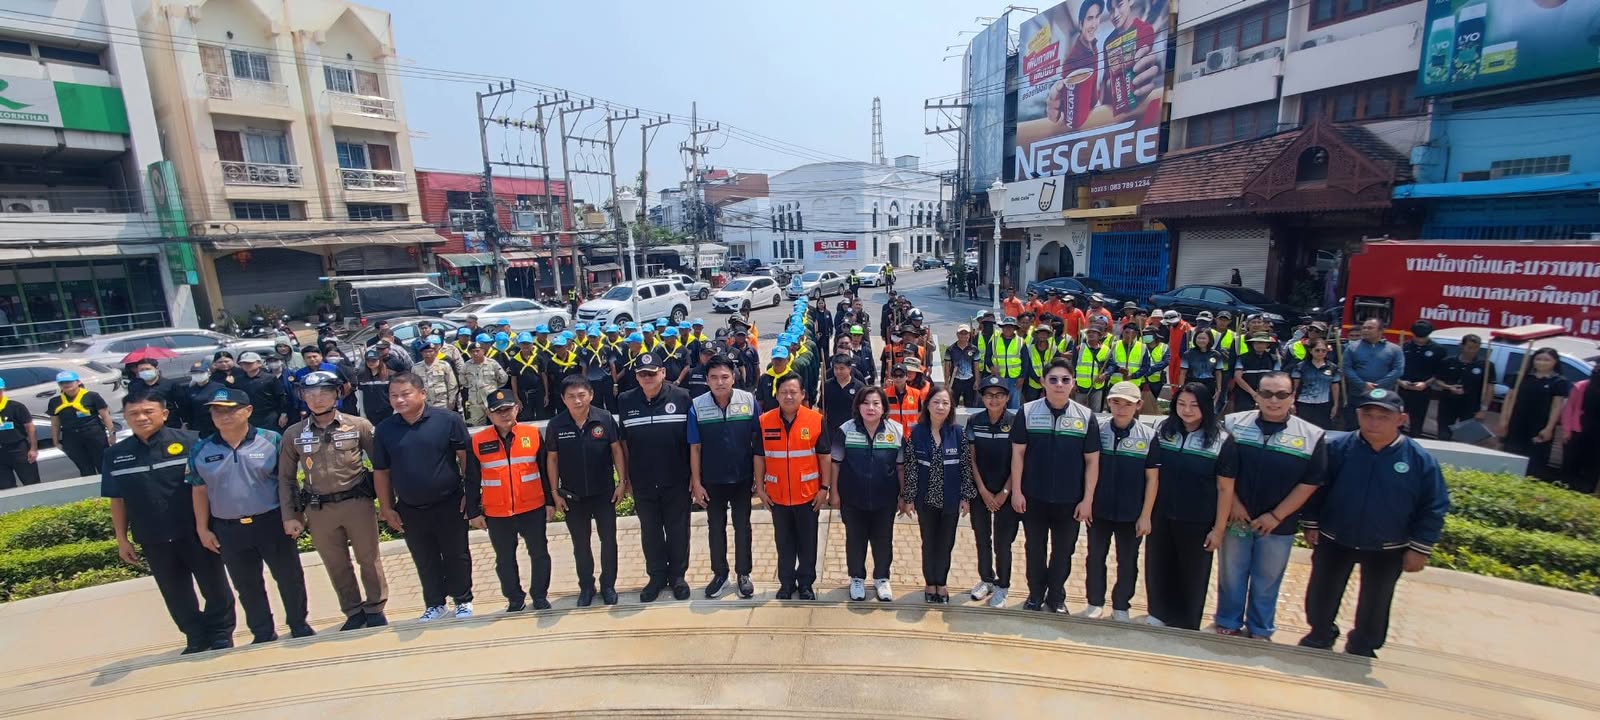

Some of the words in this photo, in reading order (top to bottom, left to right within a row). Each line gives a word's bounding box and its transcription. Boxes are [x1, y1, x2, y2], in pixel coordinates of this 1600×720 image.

[1458, 32, 1481, 43] LYO
[1109, 183, 1122, 191] 083
[1122, 181, 1134, 189] 789
[1135, 179, 1151, 188] 1234
[821, 241, 844, 249] SALE
[1420, 303, 1490, 325] เพลิงไหม้
